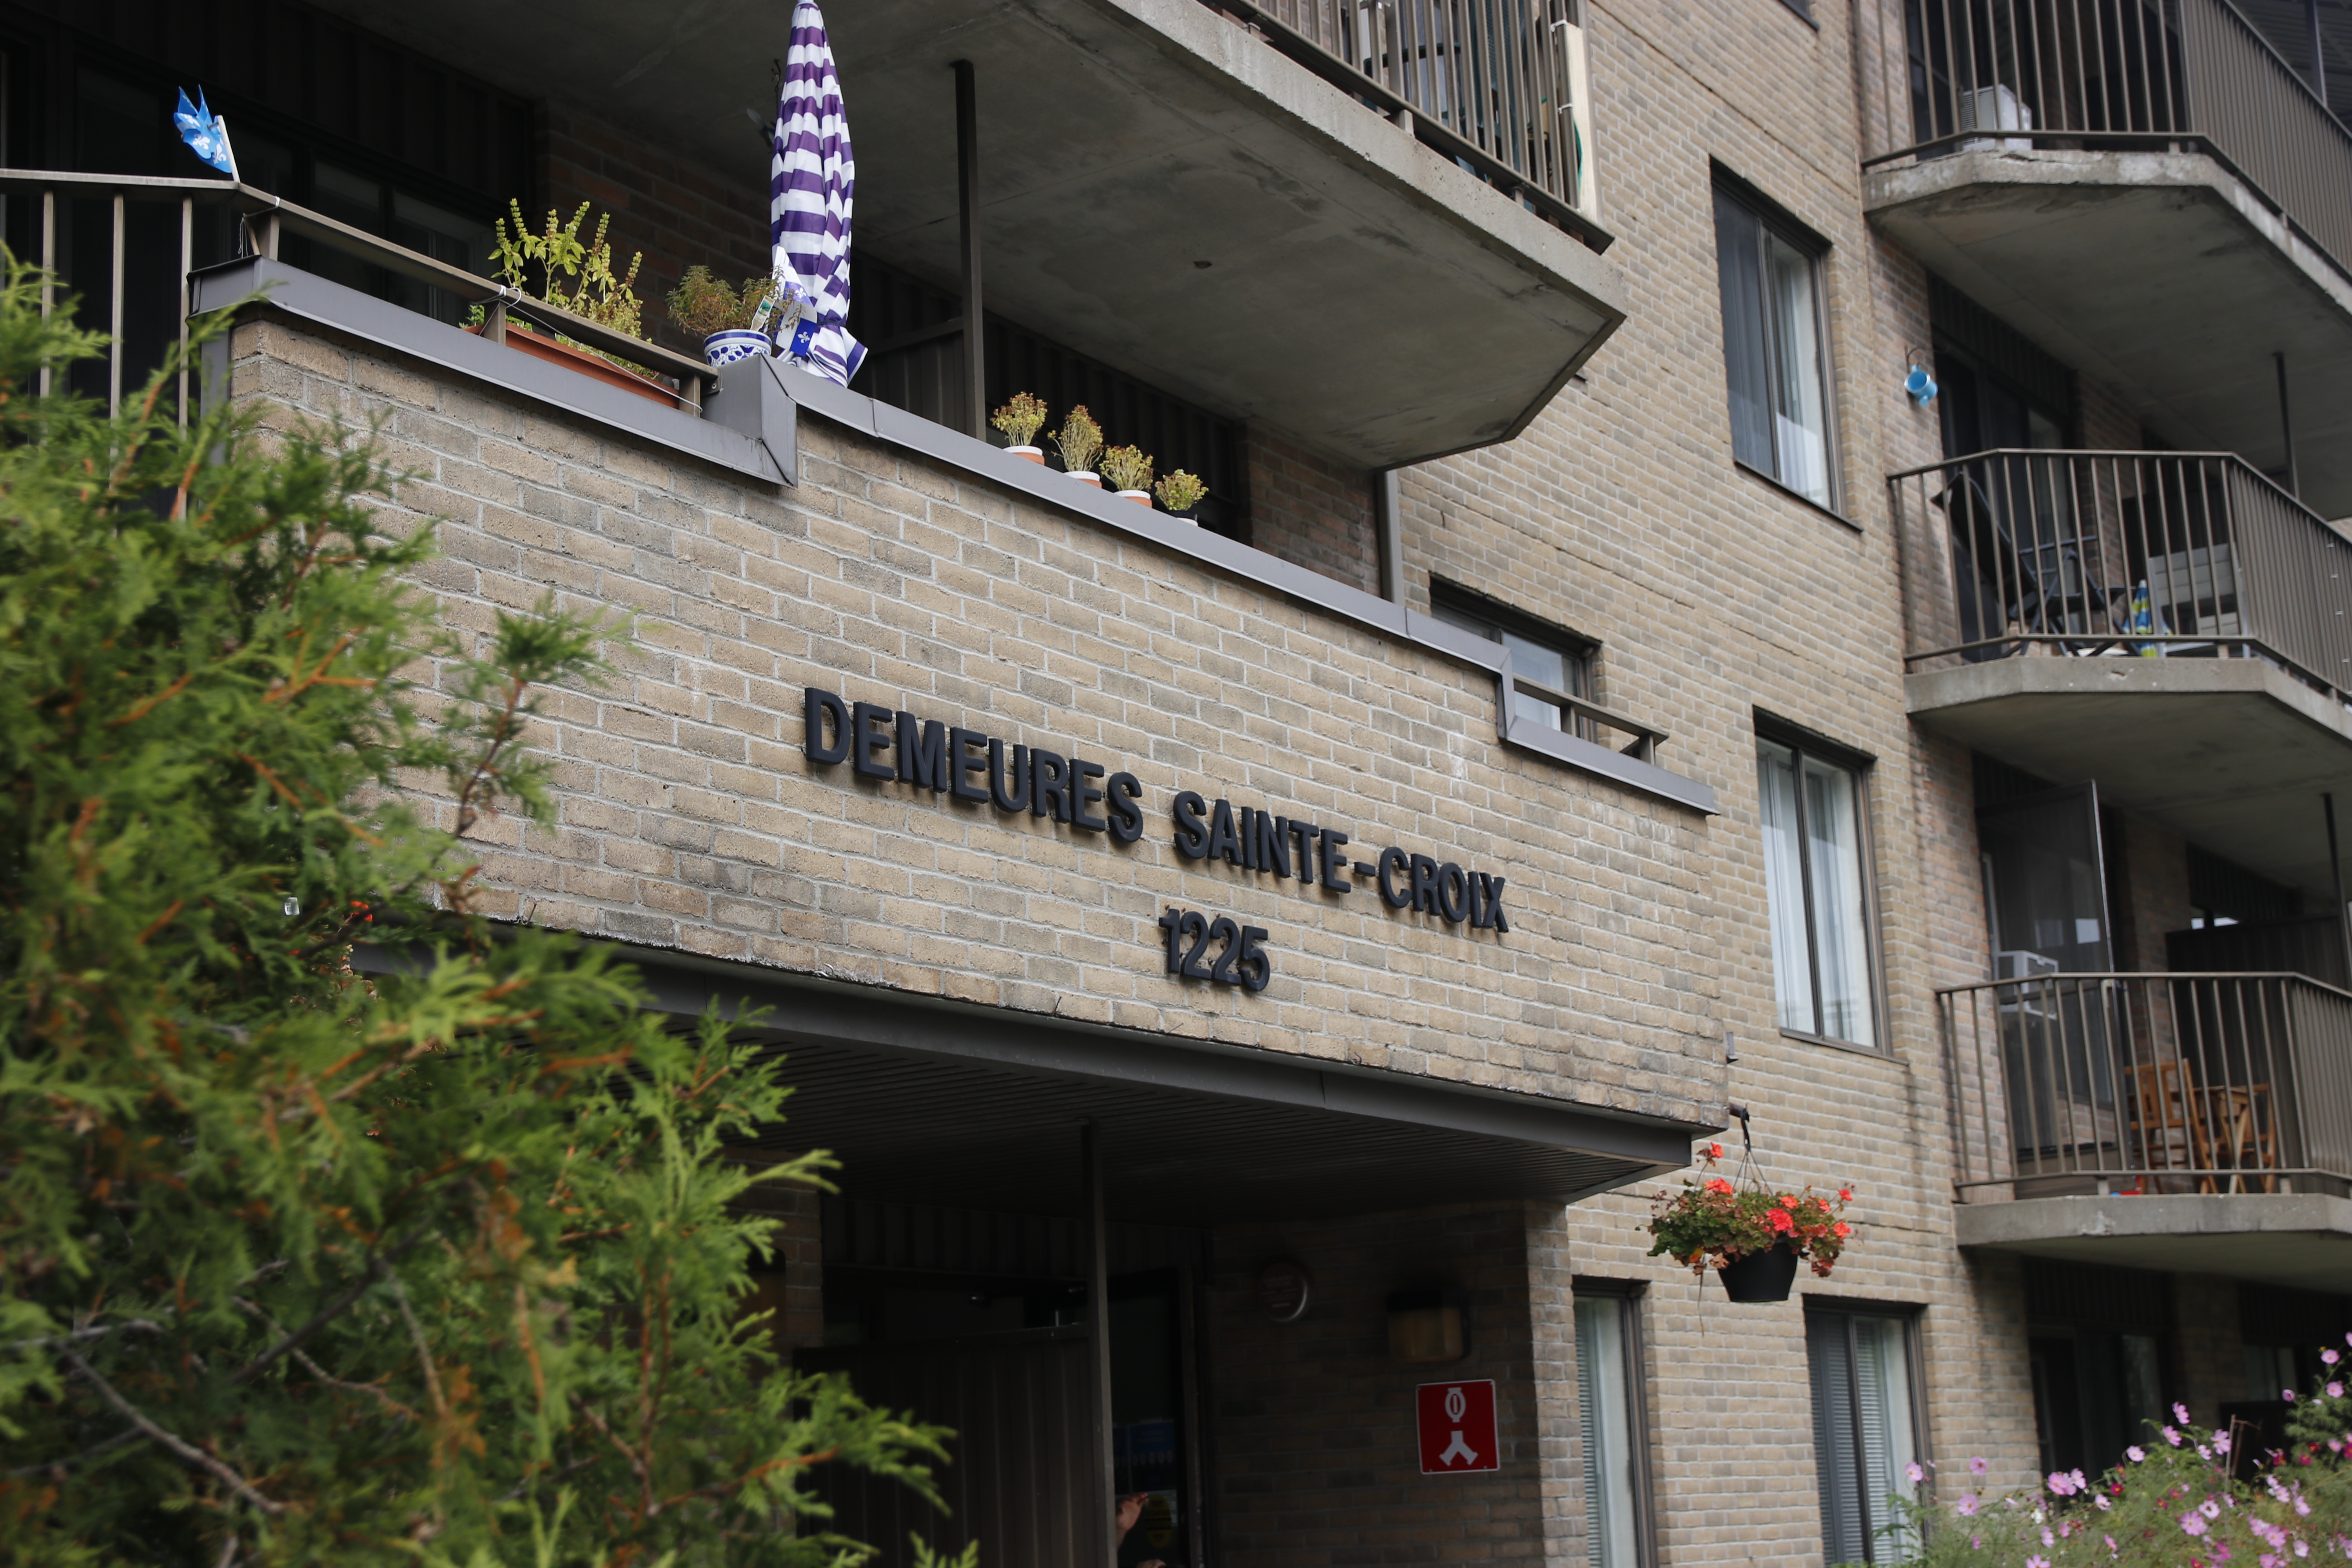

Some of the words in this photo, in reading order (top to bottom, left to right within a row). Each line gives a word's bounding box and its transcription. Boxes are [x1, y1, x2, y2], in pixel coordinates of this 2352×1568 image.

[805, 688, 1143, 842] DEMEURES
[1174, 790, 1508, 933] SAINTE-CROIX
[1159, 909, 1270, 992] 1225
